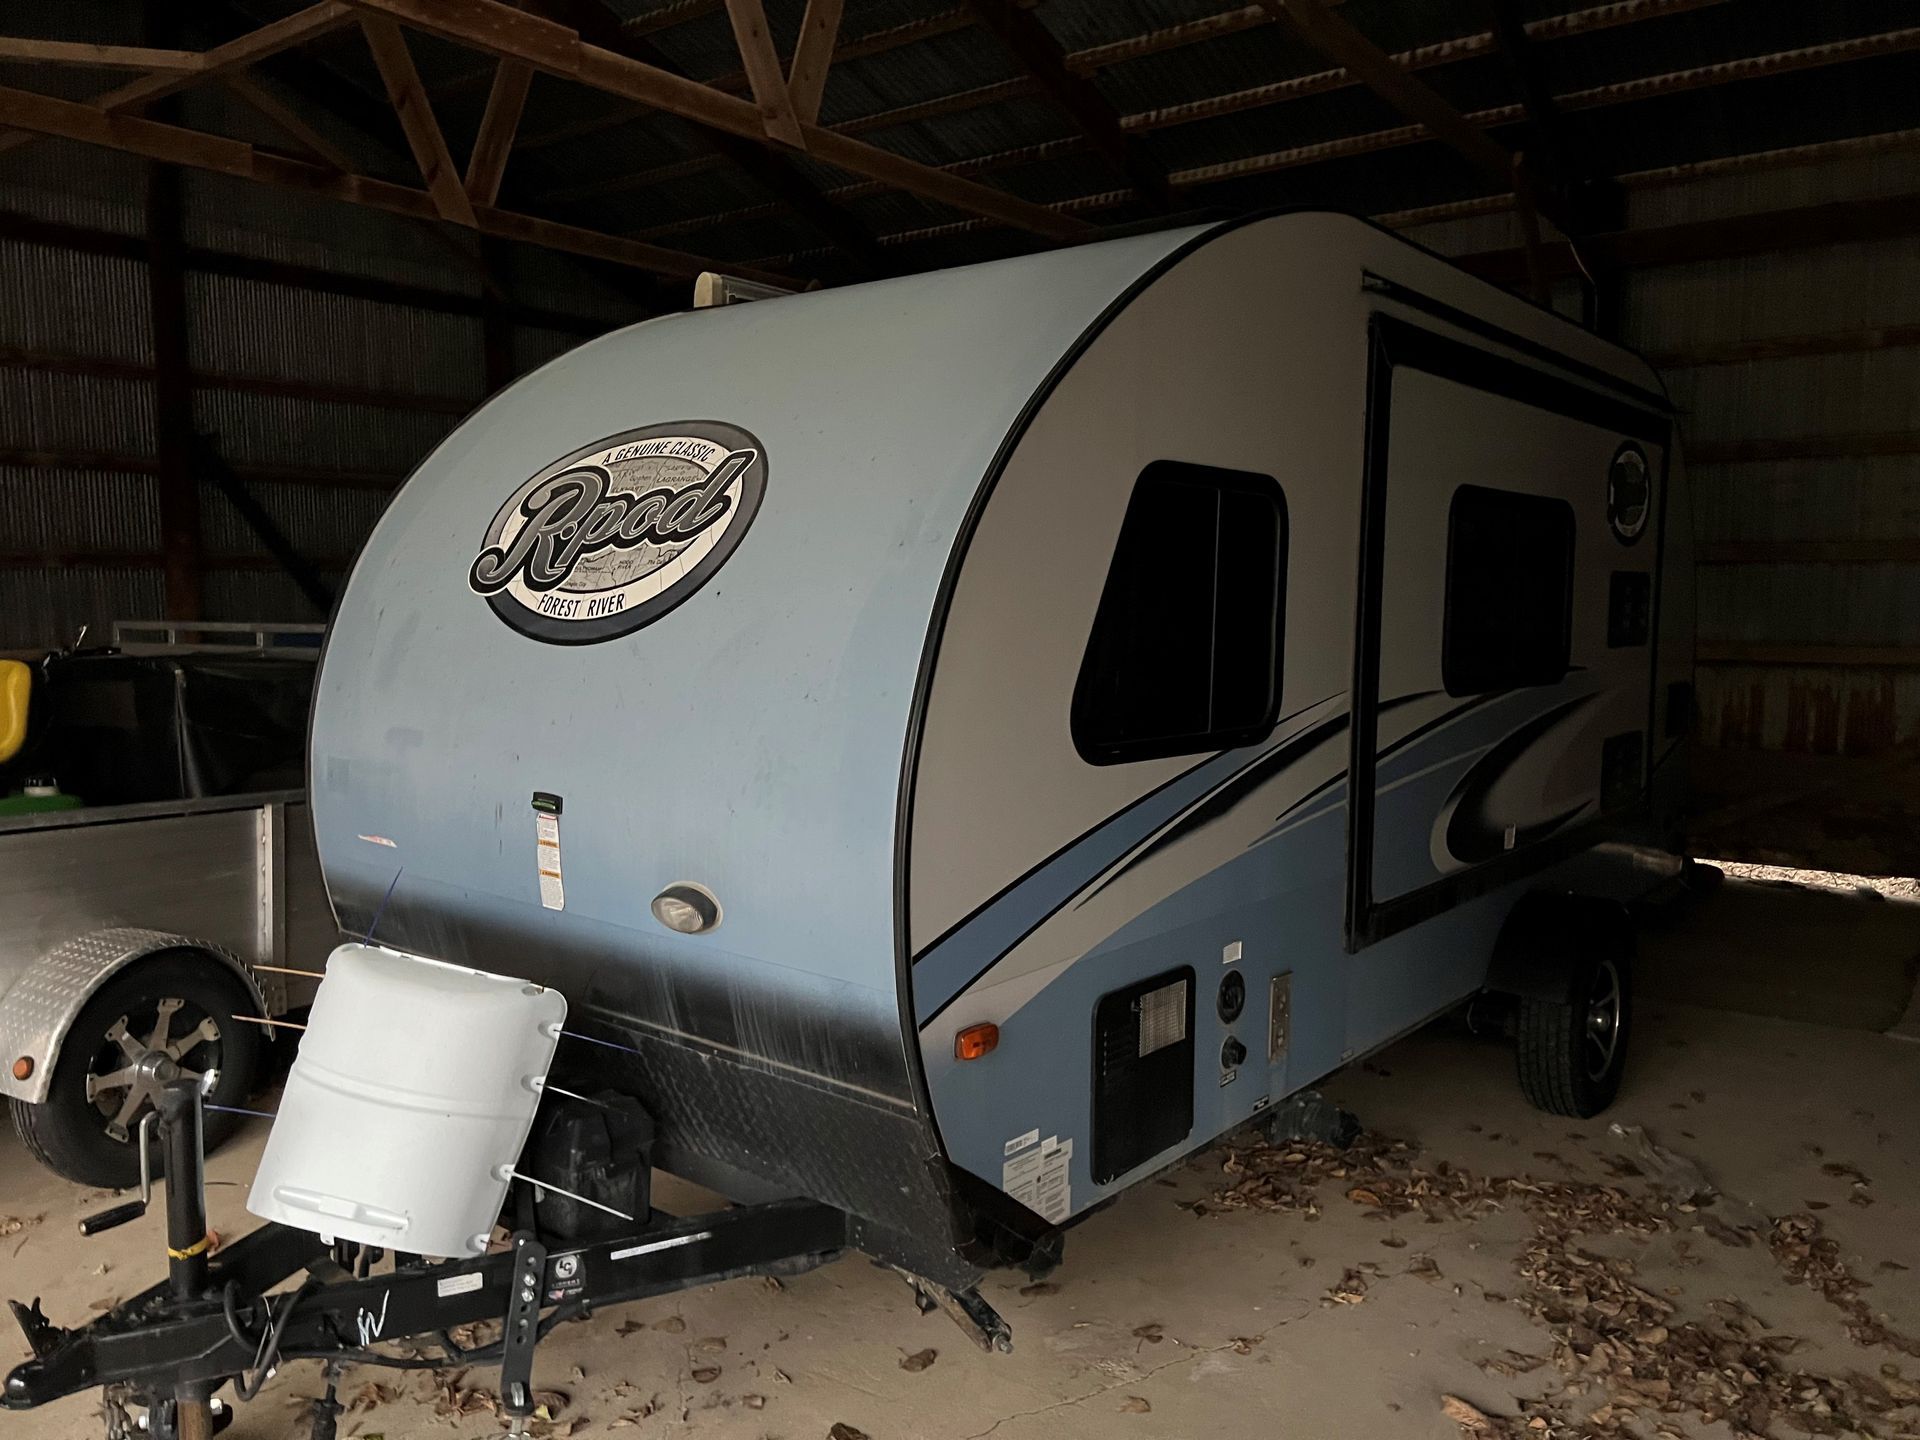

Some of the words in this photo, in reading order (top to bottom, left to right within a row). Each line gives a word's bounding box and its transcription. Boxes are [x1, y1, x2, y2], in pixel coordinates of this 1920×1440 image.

[601, 452, 611, 465] A
[615, 441, 672, 460] GENUINE
[669, 441, 715, 462] CLASSIC
[537, 594, 581, 617] FOREST
[587, 593, 624, 616] RIVER
